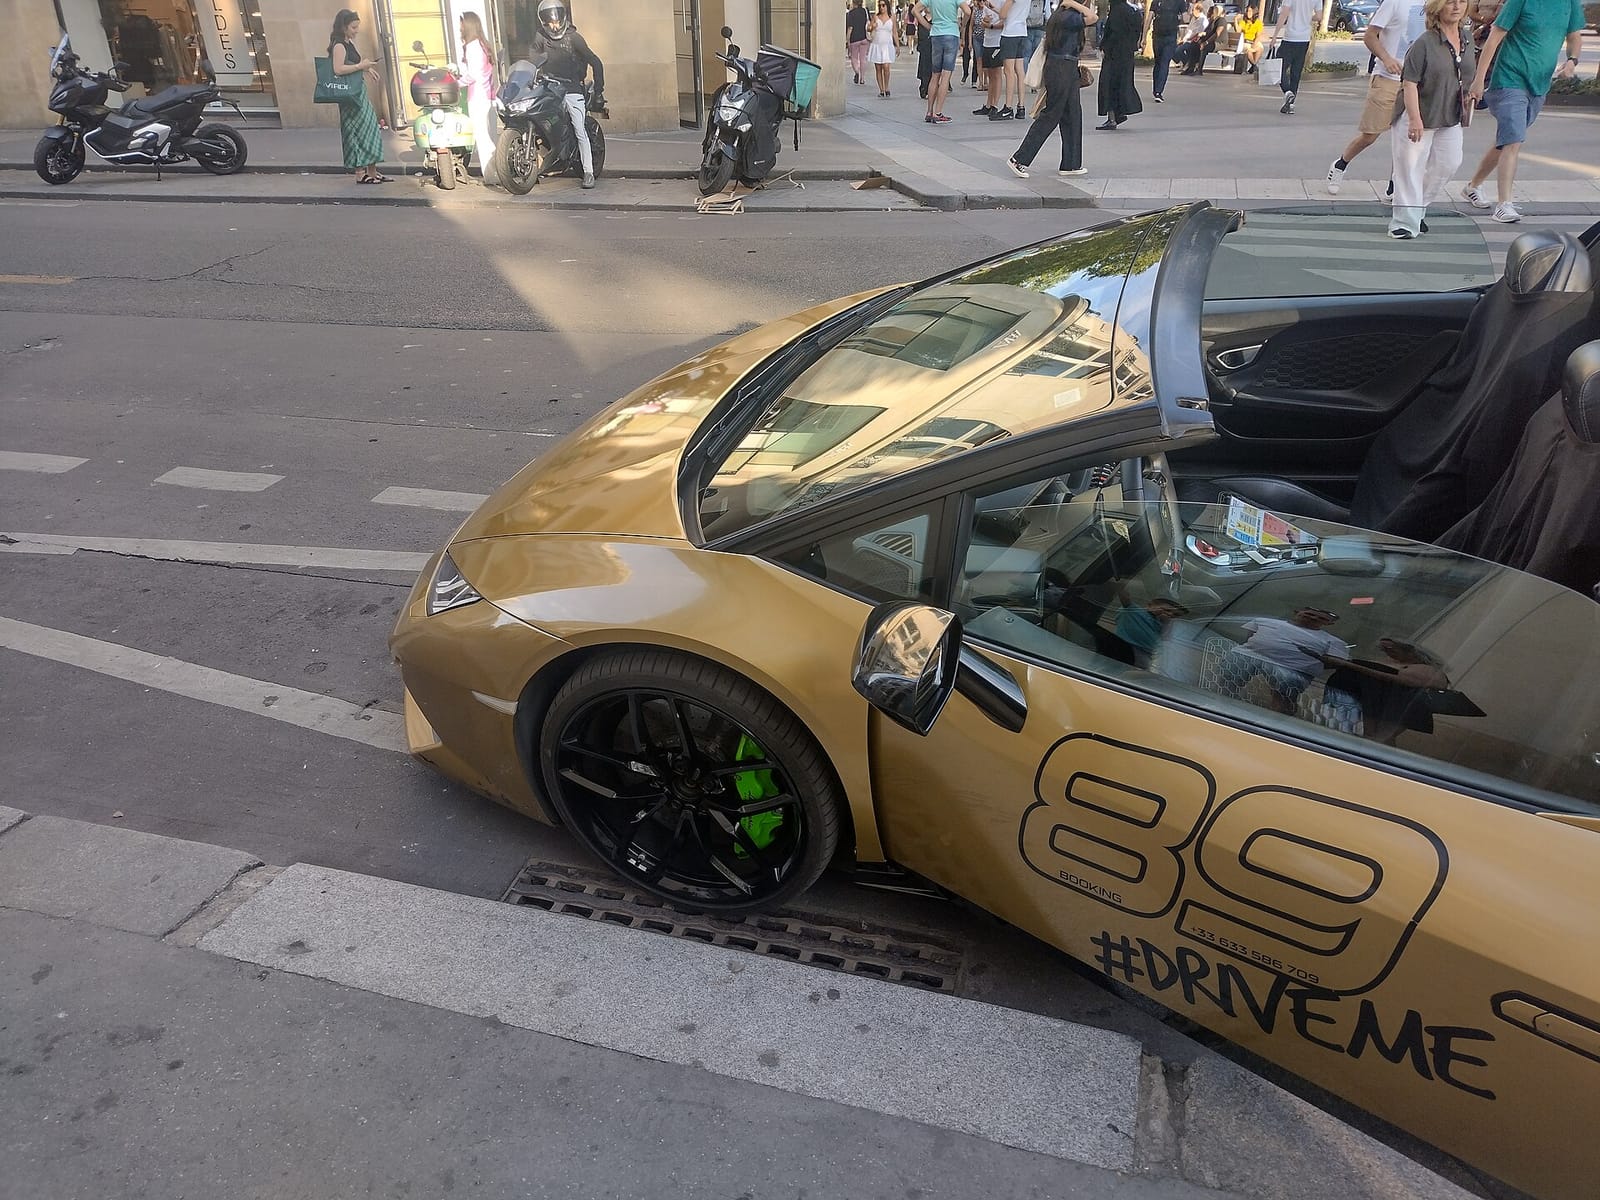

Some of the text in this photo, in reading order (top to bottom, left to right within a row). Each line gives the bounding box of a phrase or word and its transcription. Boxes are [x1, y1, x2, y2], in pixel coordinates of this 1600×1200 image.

[1018, 732, 1450, 997] 89
[1060, 870, 1122, 904] BOOKING
[1190, 926, 1320, 984] +33 633 586 709
